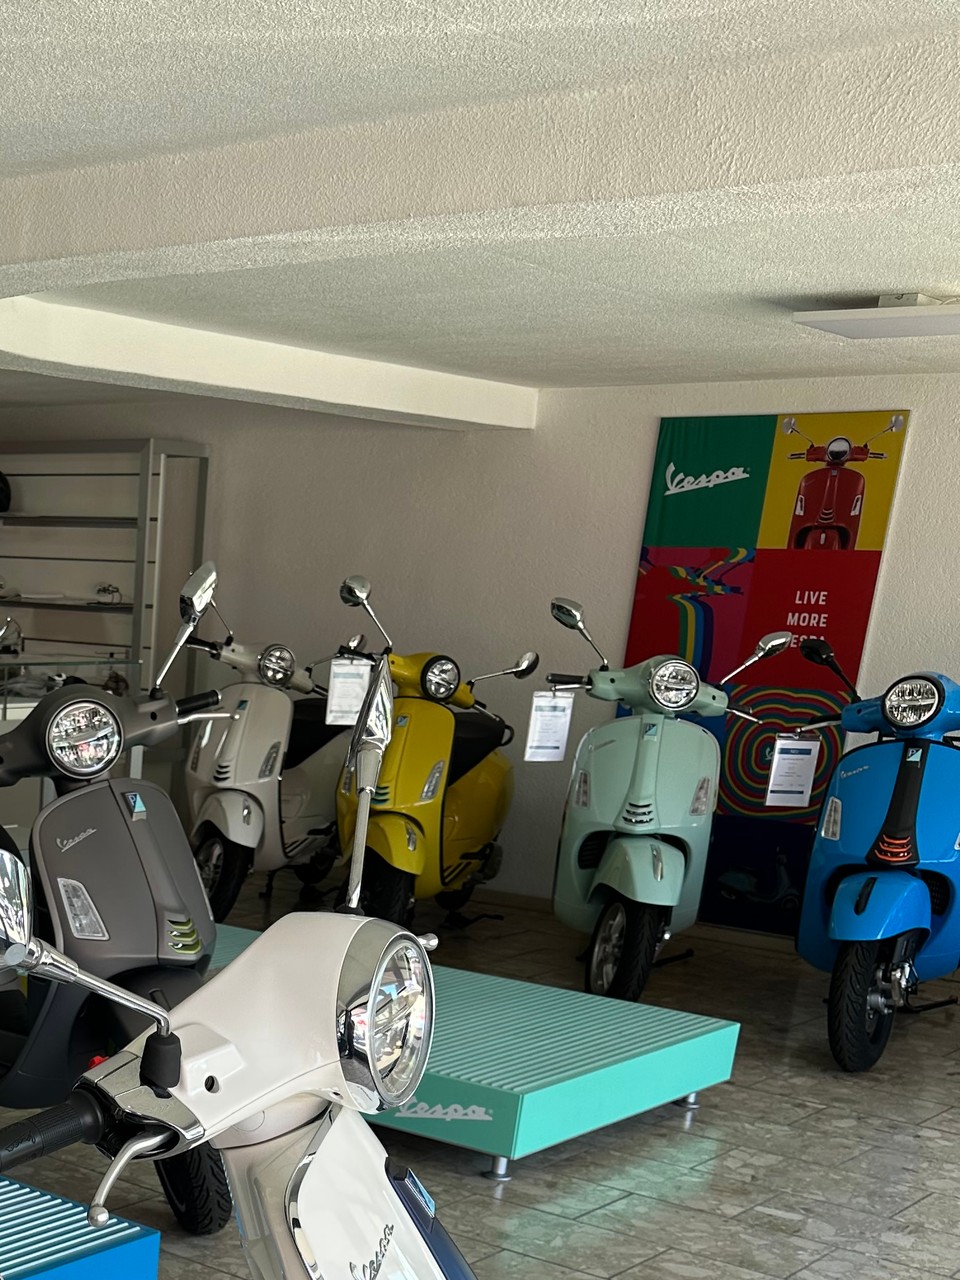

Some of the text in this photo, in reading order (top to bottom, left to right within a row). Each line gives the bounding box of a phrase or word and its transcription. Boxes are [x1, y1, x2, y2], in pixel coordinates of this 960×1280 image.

[664, 462, 750, 496] Vespa
[795, 590, 828, 605] LIVE
[786, 612, 828, 627] MORE
